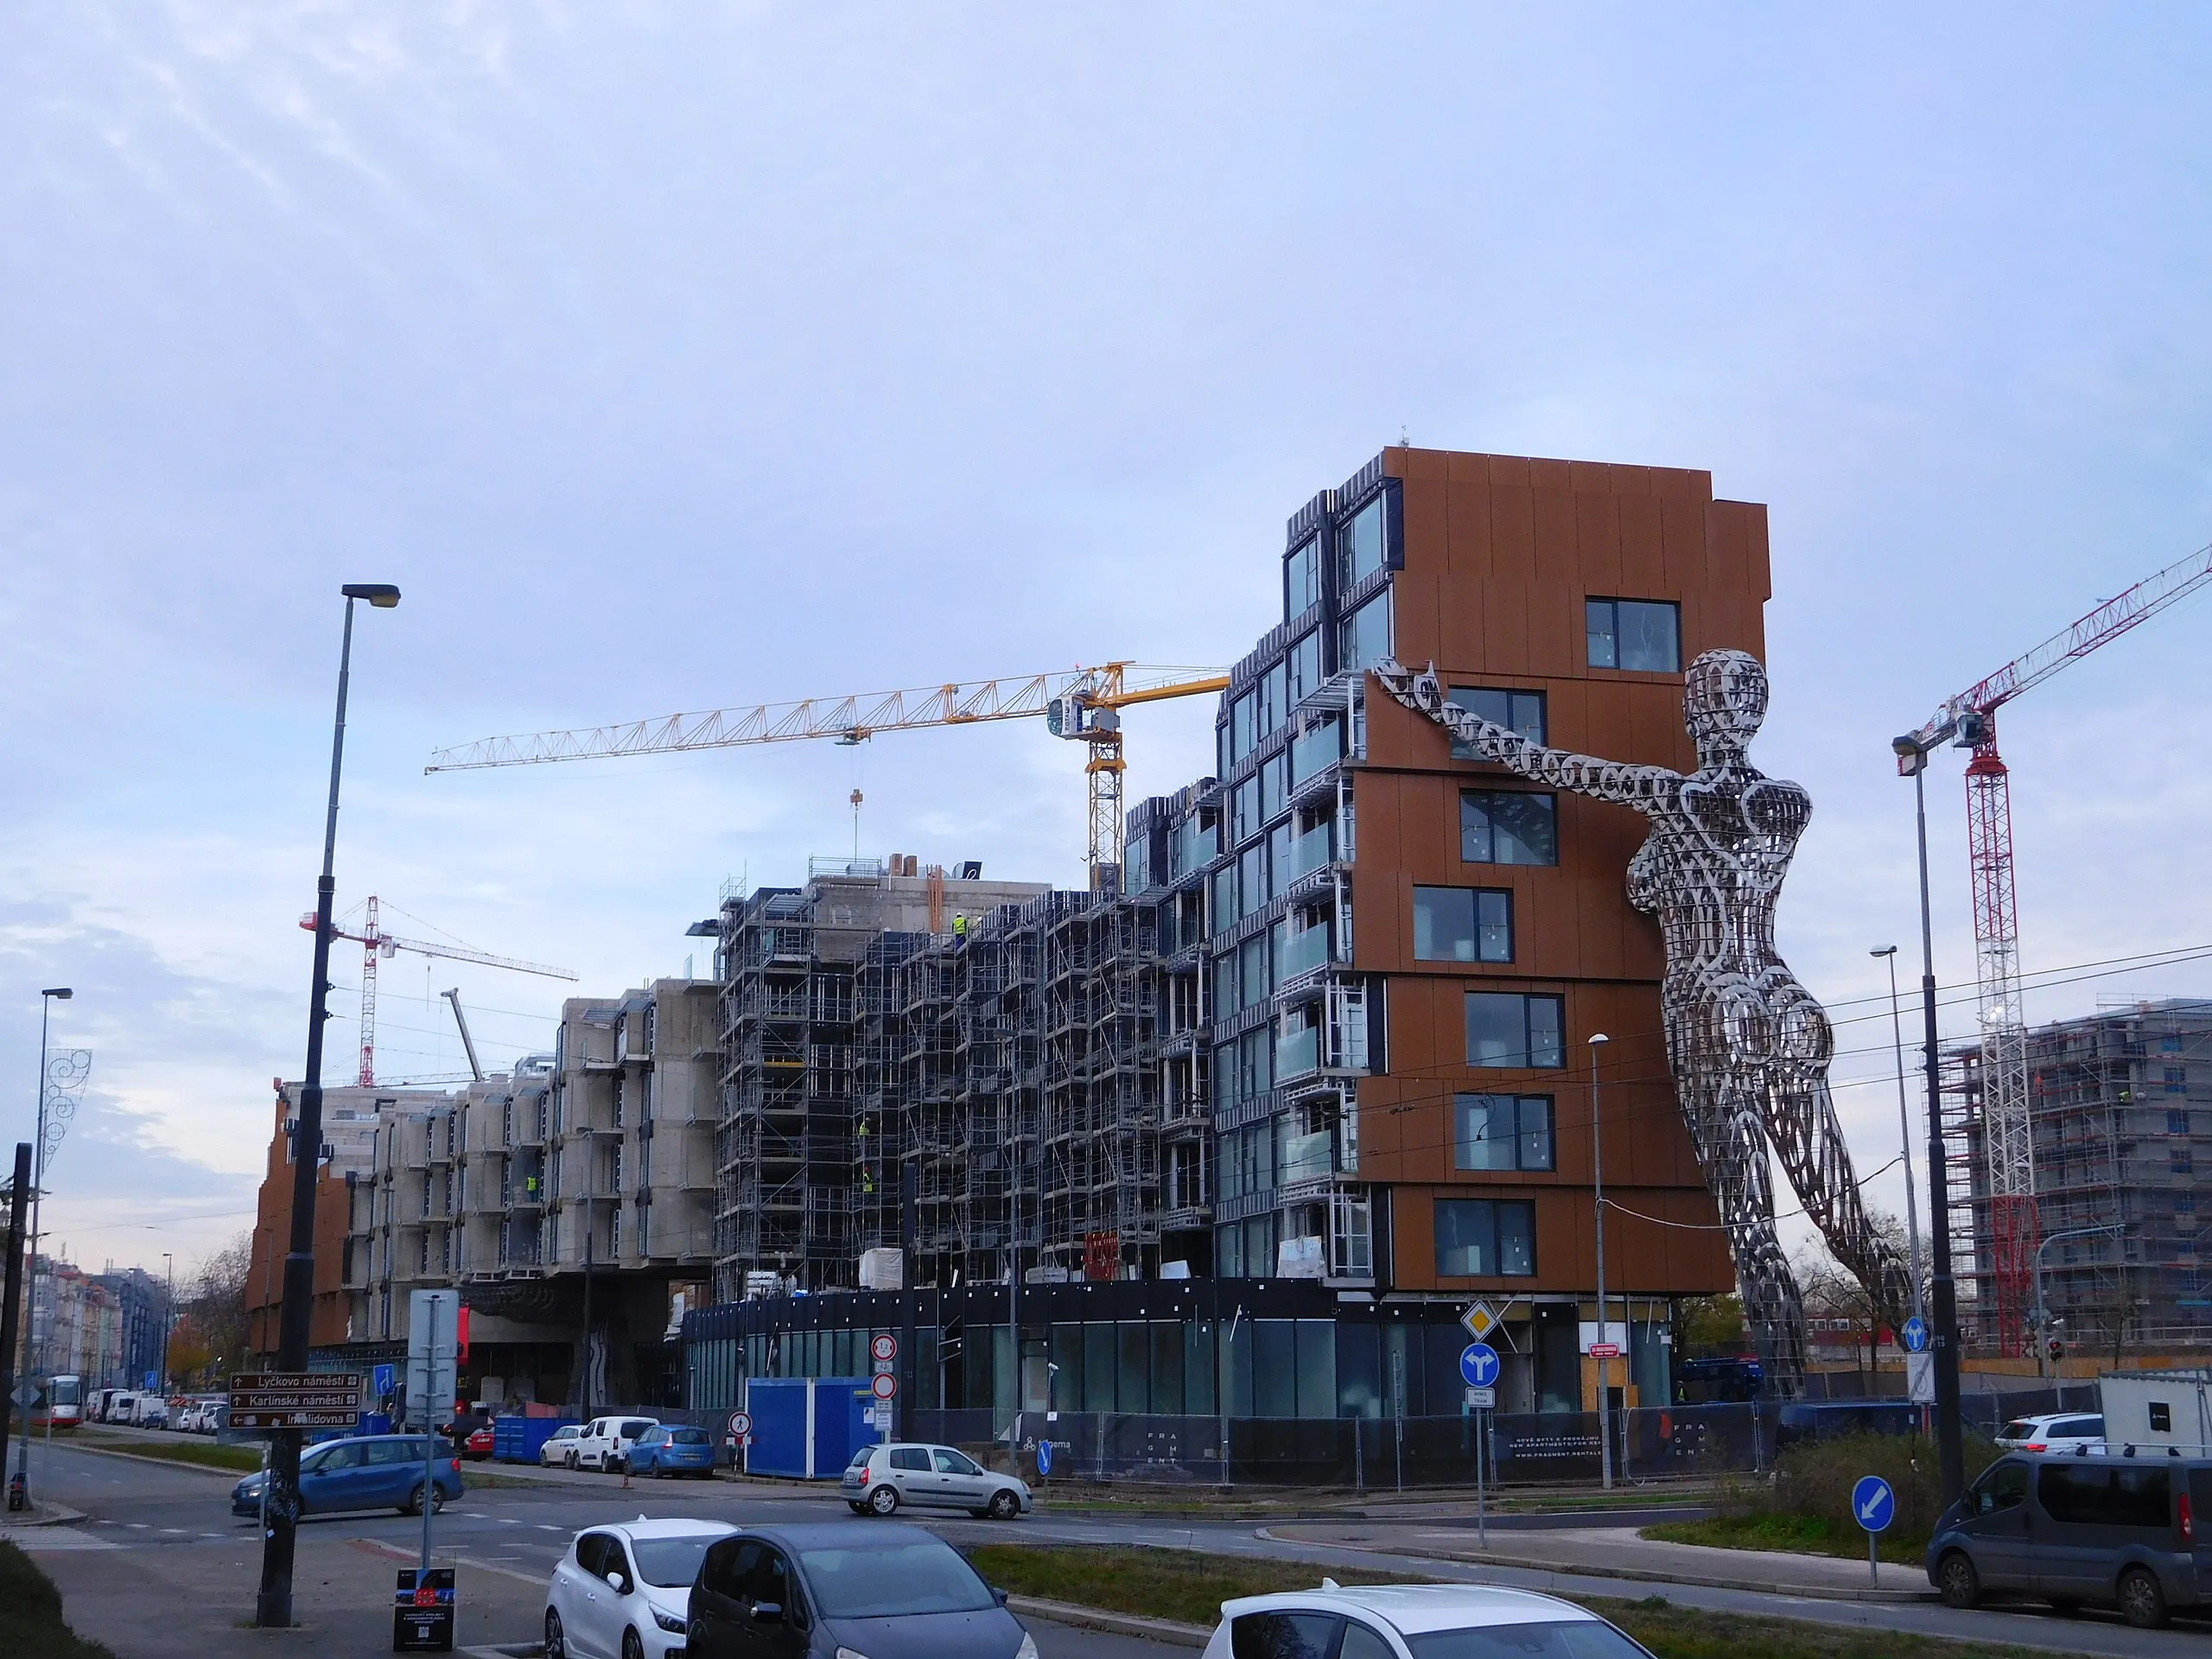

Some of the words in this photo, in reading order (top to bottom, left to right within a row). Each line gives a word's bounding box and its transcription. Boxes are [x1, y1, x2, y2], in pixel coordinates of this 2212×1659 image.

[258, 1376, 299, 1389] Lyčkovo
[303, 1376, 344, 1385] náměstí
[250, 1395, 299, 1406] Karlínské
[302, 1395, 343, 1405] náměstí
[1039, 1440, 1071, 1450] tgema
